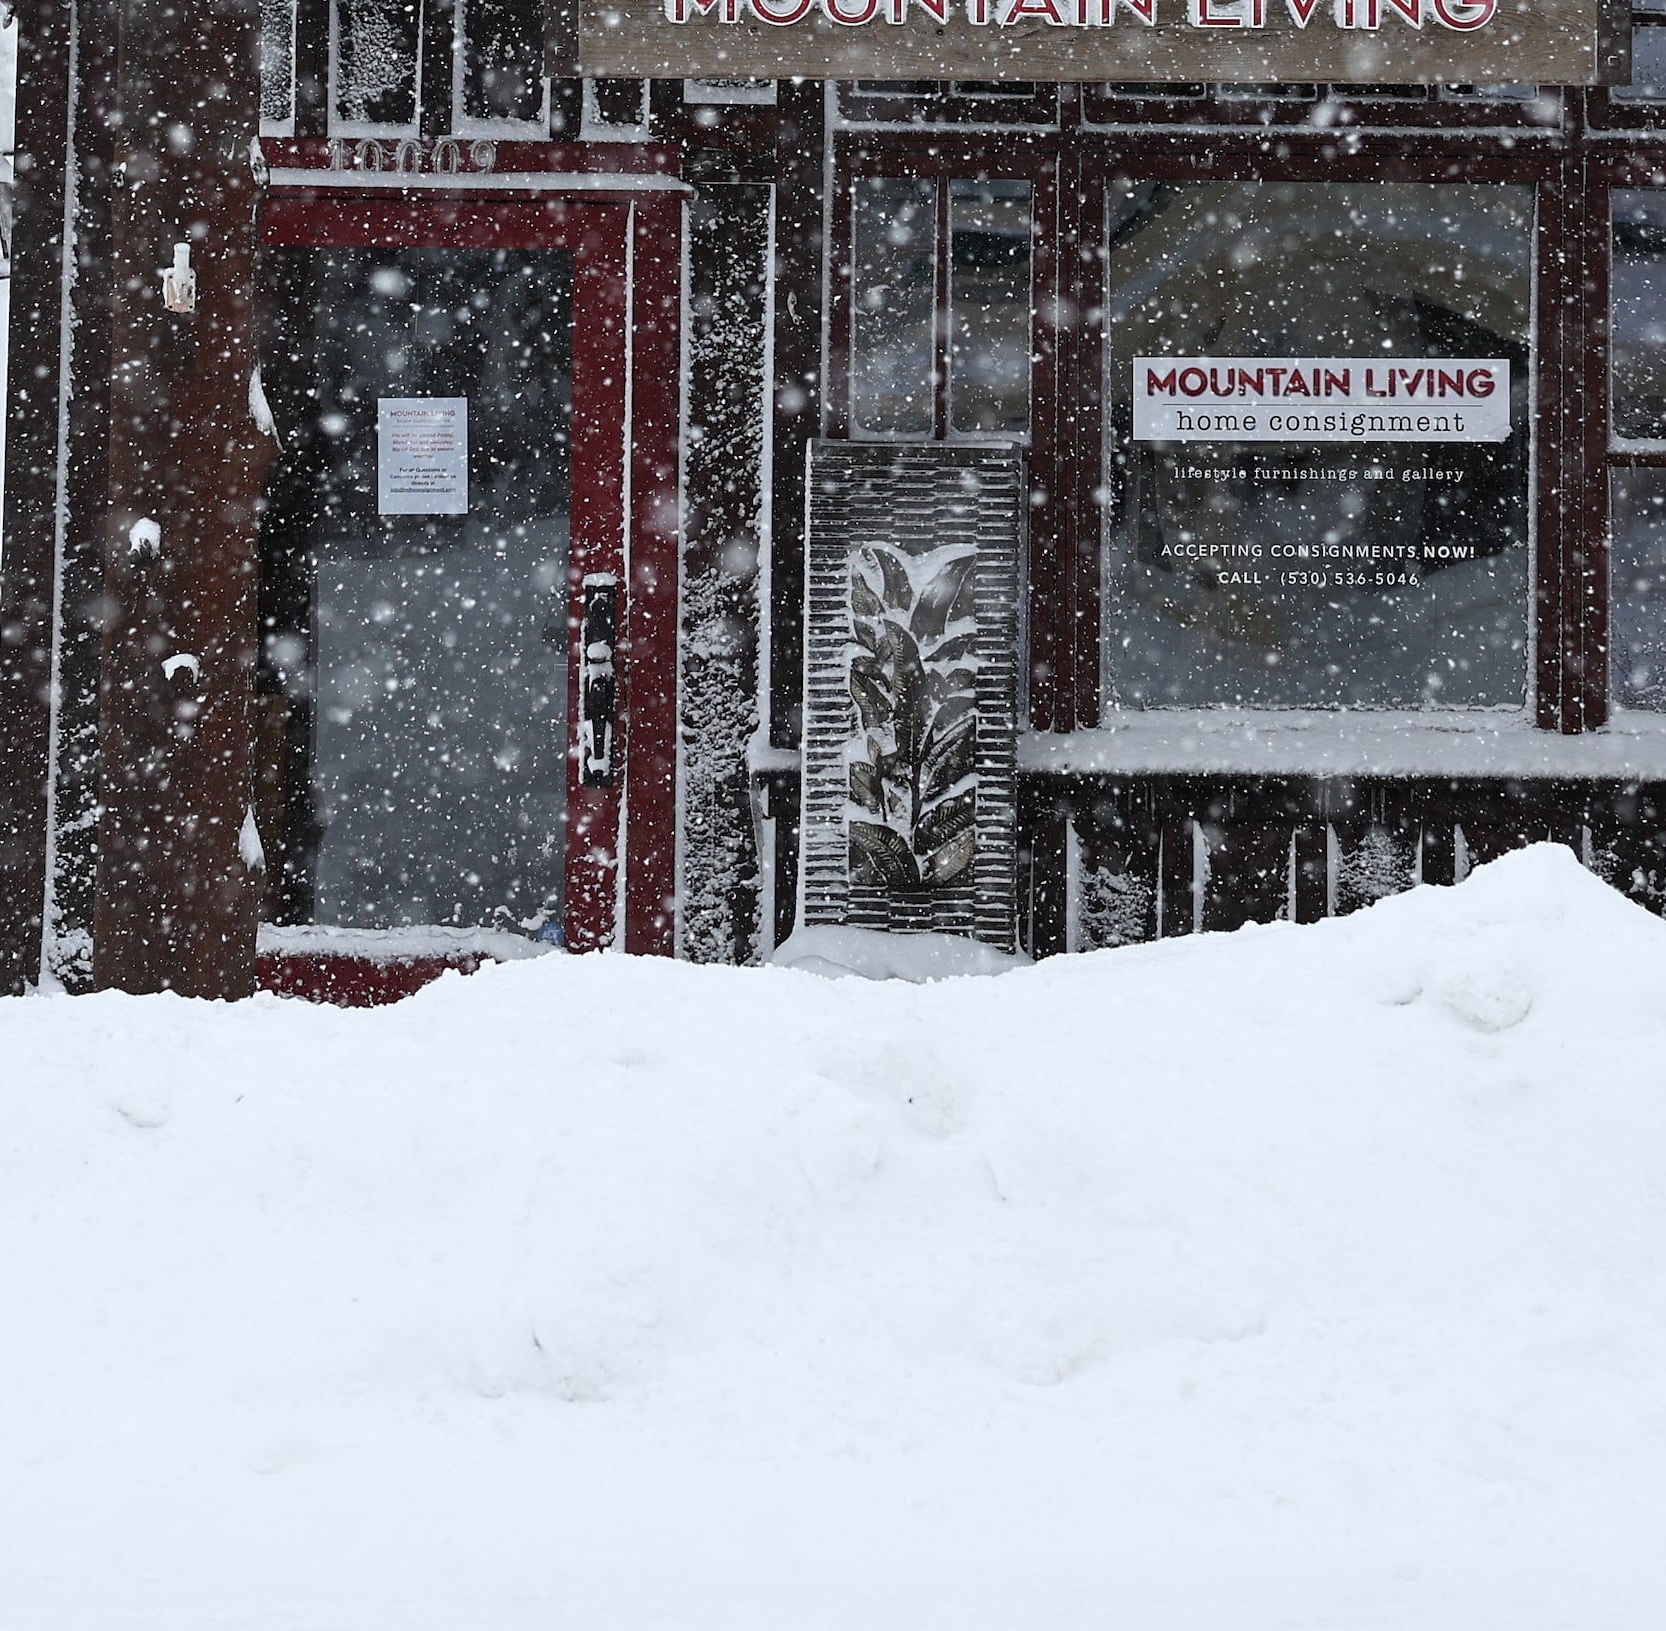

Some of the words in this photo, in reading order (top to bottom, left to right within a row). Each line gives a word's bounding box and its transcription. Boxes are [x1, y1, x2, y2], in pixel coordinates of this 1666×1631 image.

[330, 138, 496, 174] 10009
[1146, 366, 1347, 398] MOUNTAIN
[1366, 368, 1496, 399] LIVING
[1175, 410, 1257, 433] home
[1268, 411, 1465, 438] consignment
[1254, 467, 1358, 482] furnishings
[1363, 467, 1395, 480] and
[1401, 467, 1465, 482] gallery
[1161, 543, 1263, 558] ACCEPTING
[1270, 543, 1417, 559] CONSIGNMENTS
[1423, 545, 1476, 559] NOW!
[1280, 571, 1328, 586] (530)
[1334, 571, 1419, 586] 536-5046
